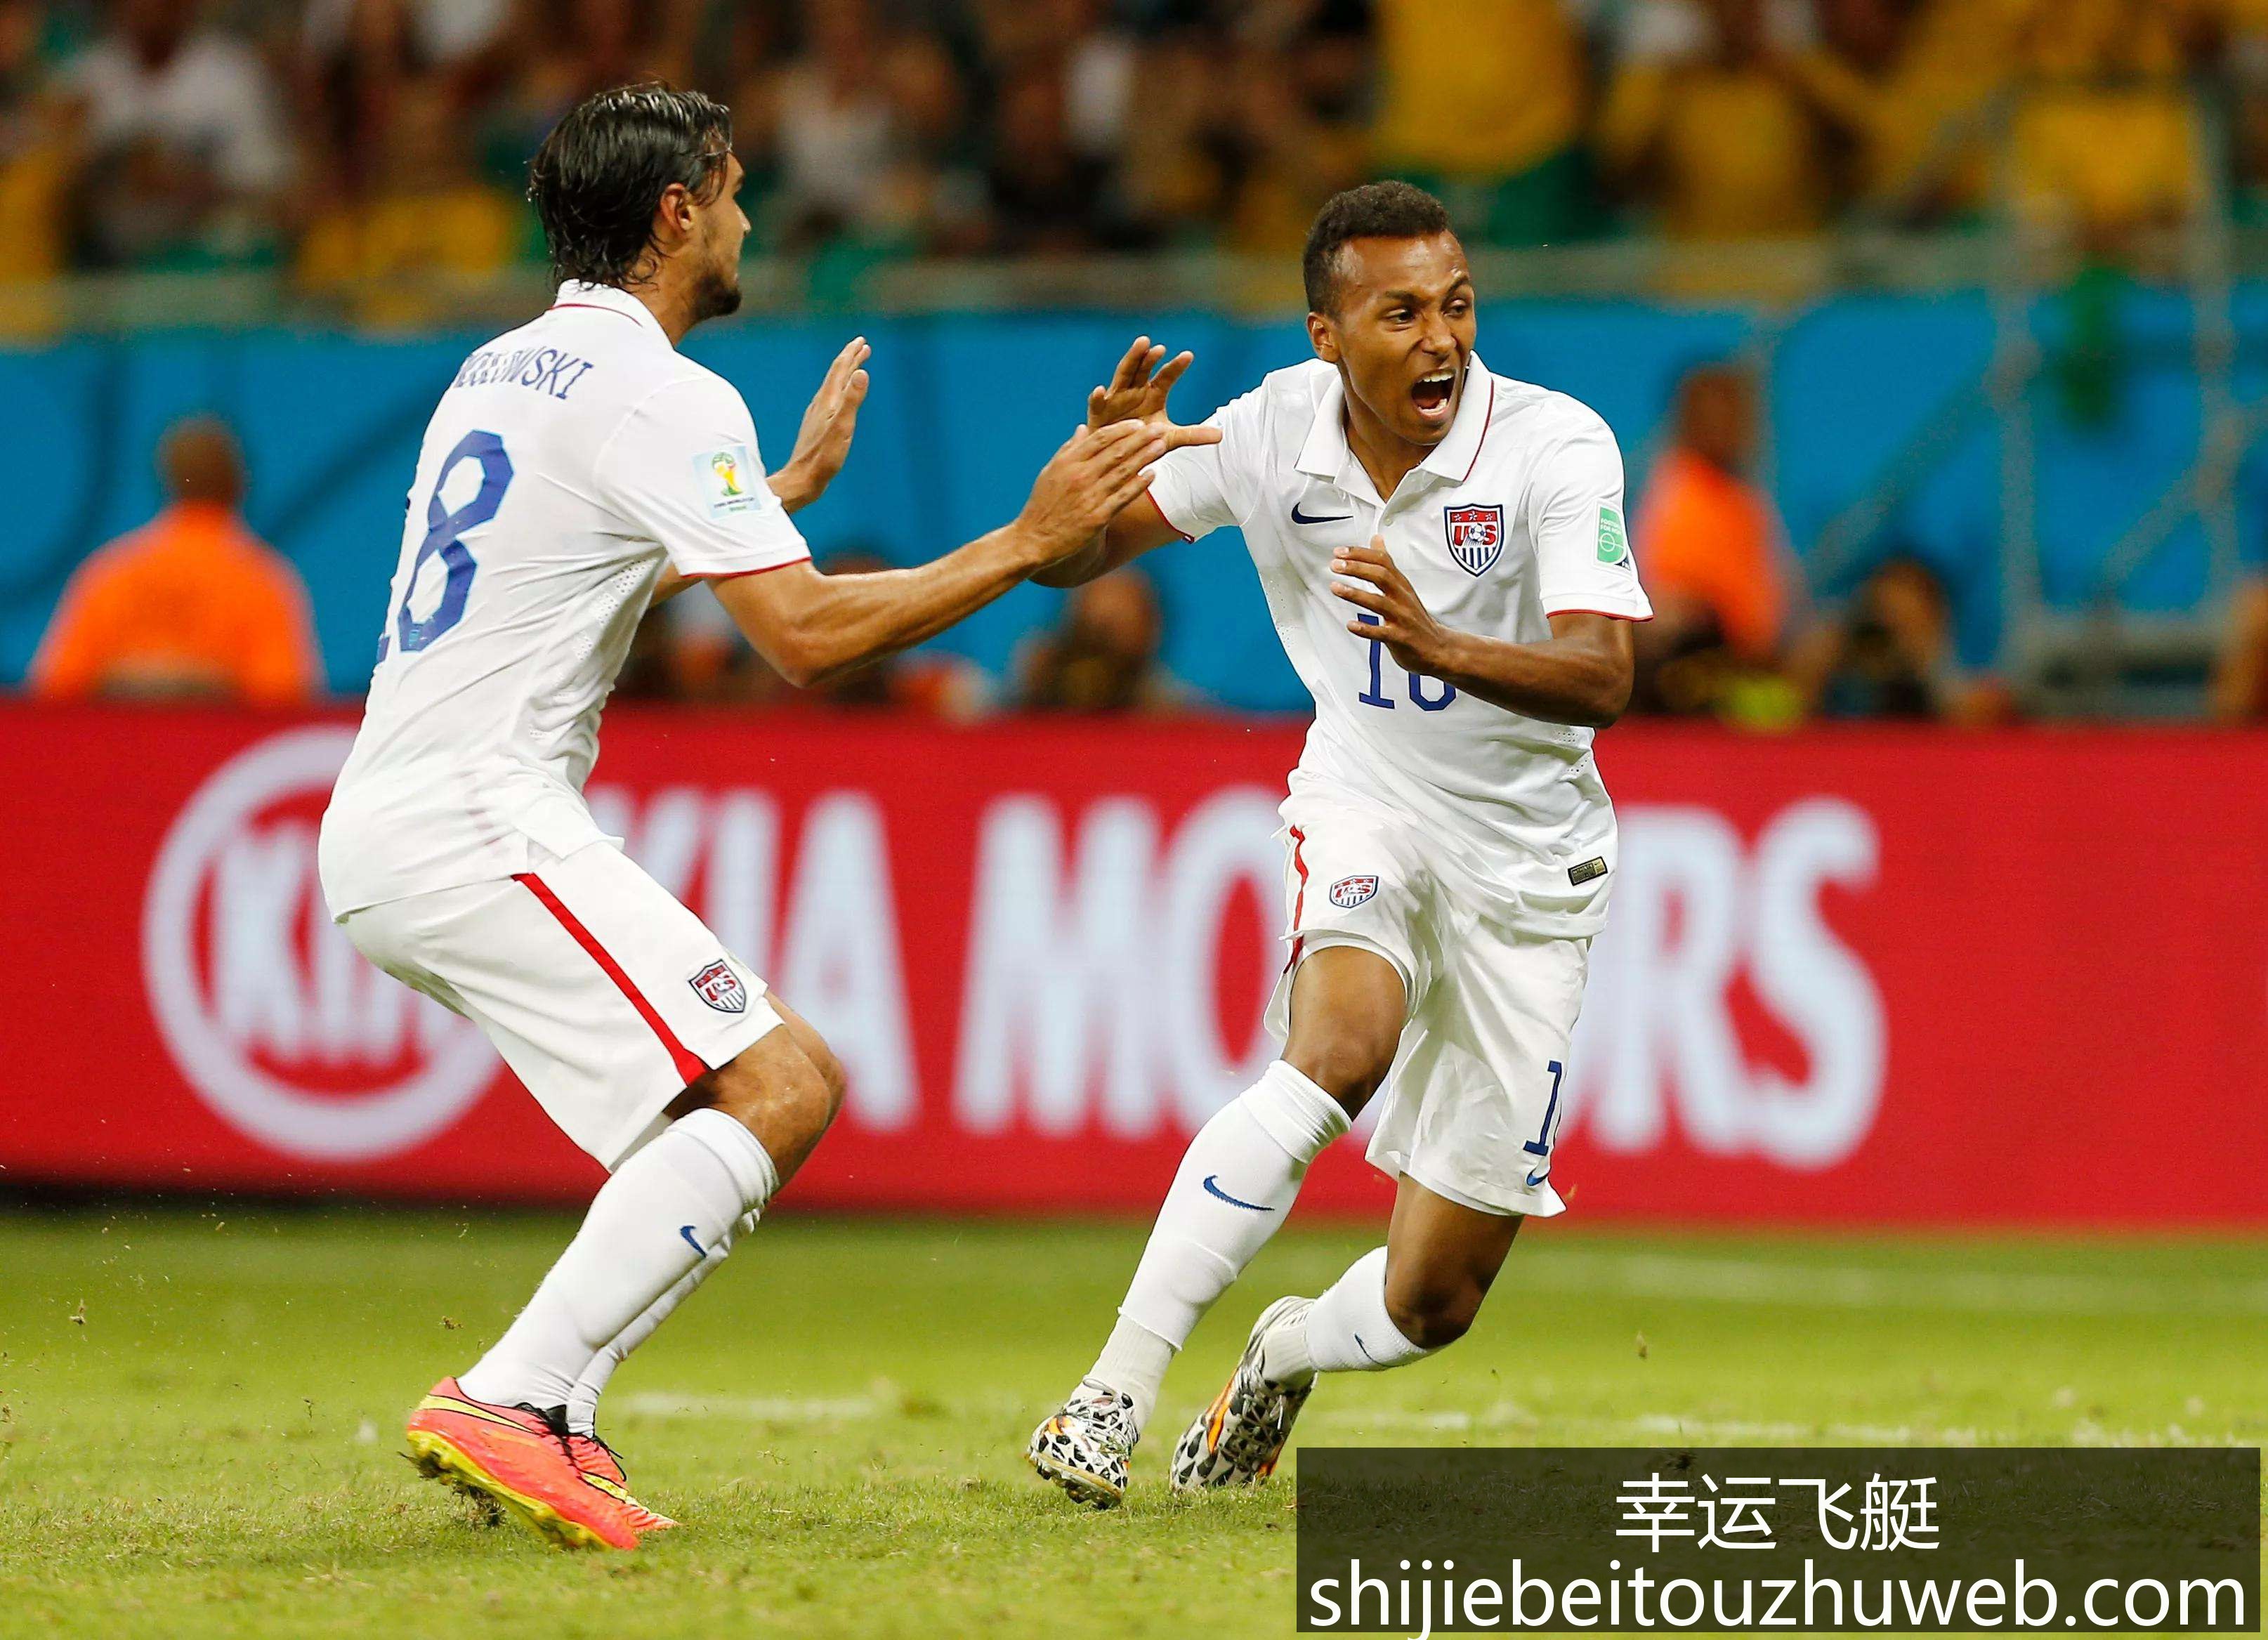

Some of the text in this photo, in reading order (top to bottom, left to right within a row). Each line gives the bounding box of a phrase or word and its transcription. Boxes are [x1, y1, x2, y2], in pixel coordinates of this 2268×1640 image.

[376, 428, 514, 662] 8
[1453, 524, 1497, 546] US
[950, 783, 1889, 1167] MORS
